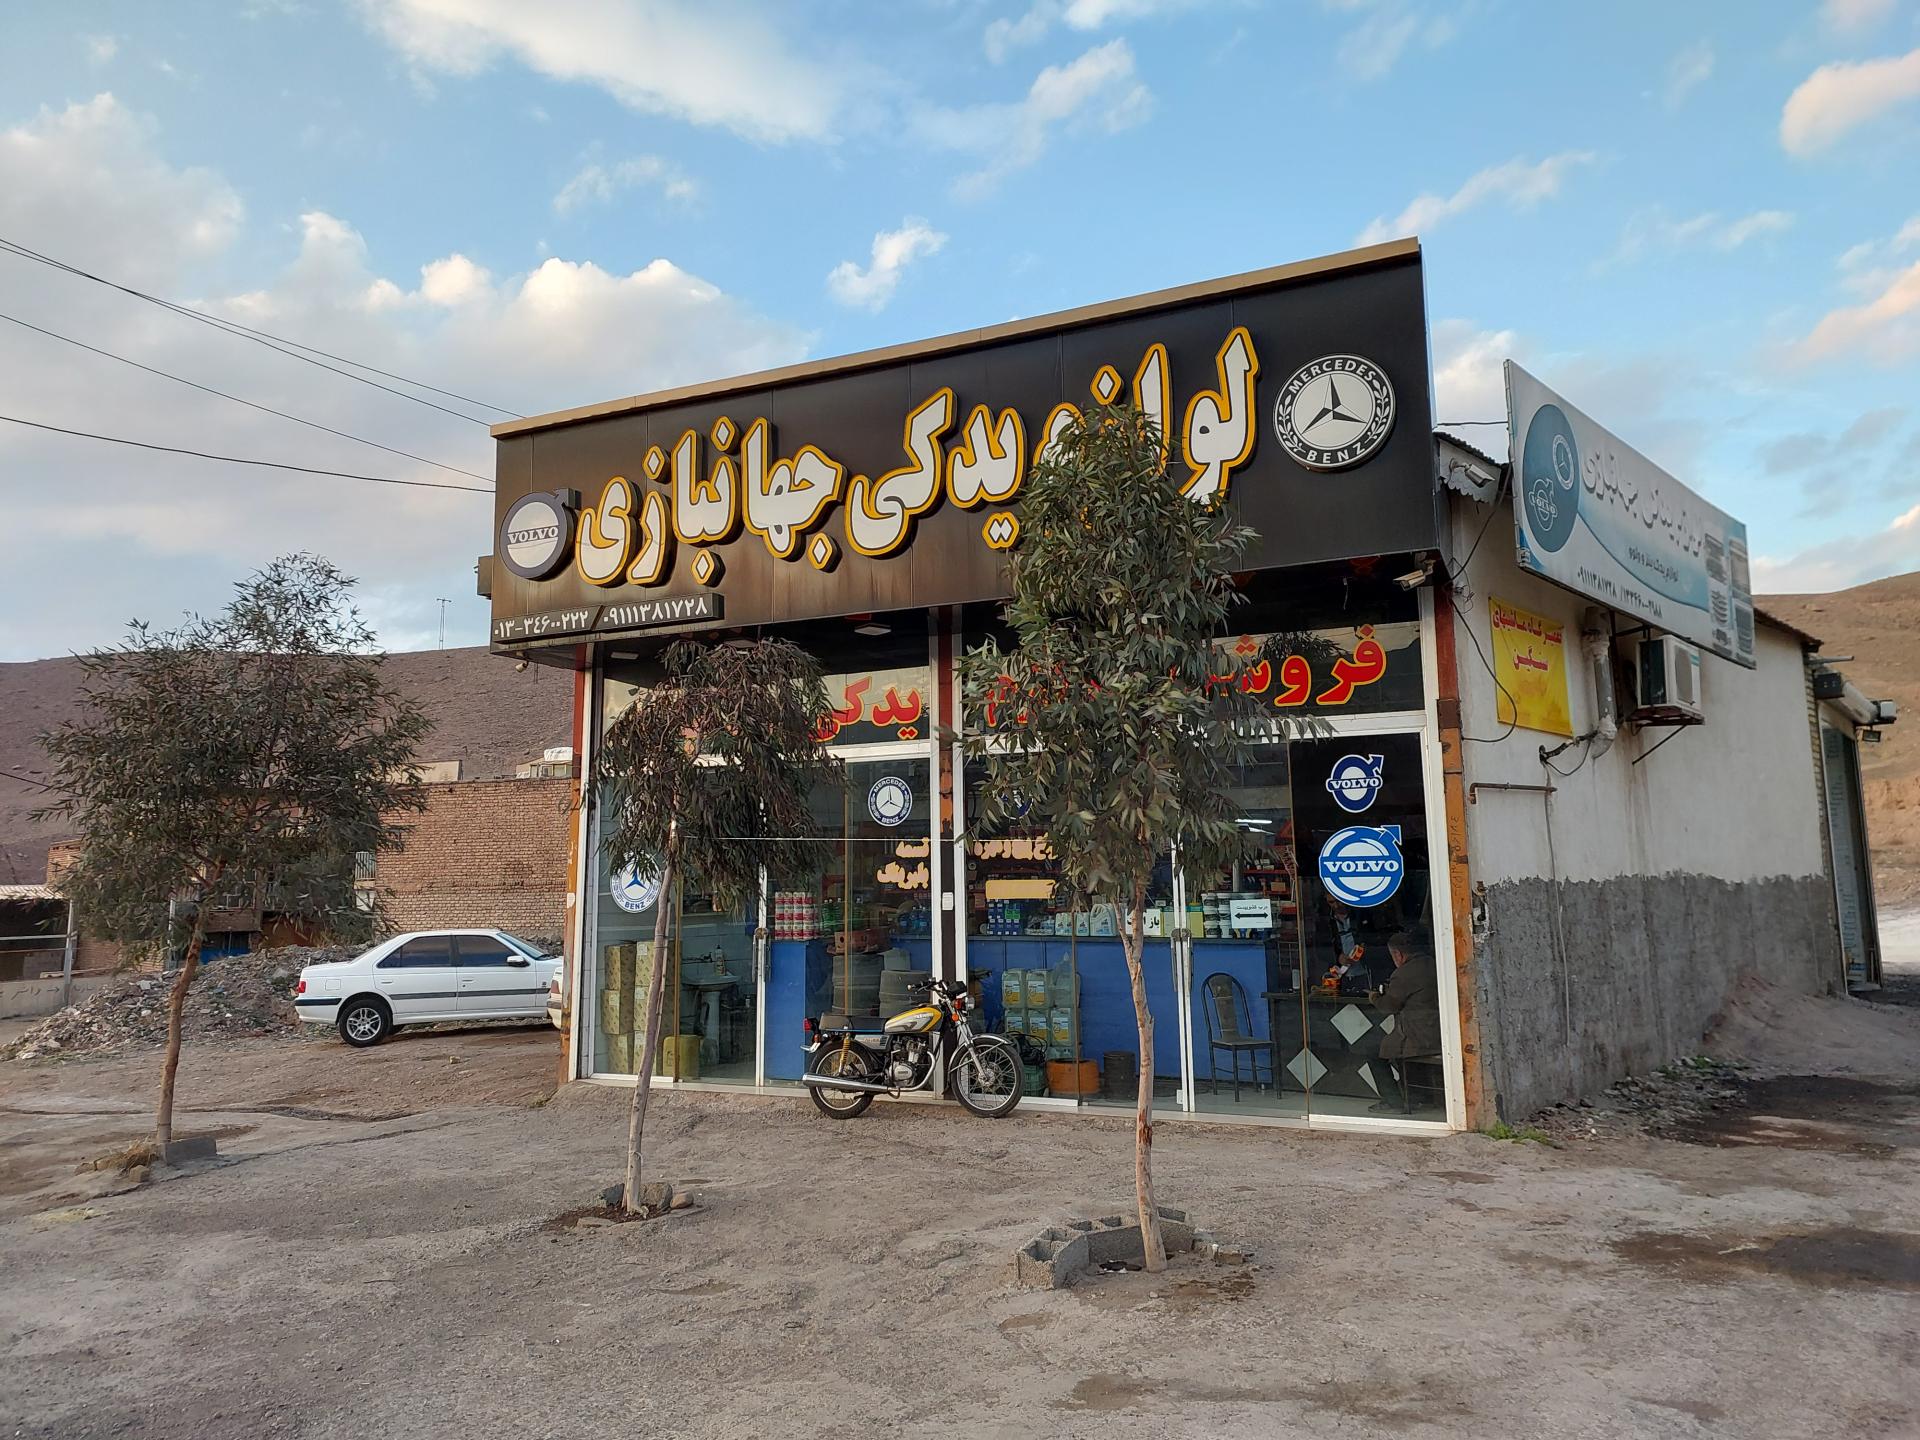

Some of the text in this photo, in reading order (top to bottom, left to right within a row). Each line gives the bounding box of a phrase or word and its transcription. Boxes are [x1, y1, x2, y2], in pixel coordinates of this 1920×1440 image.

[1289, 359, 1377, 394] MERCEDES
[1306, 442, 1366, 464] BENZ
[845, 386, 1027, 557] یدکی
[576, 416, 846, 585] جهانبازی
[507, 526, 559, 544] VOLVO
[873, 778, 906, 793] MERCEDES
[1329, 777, 1381, 789] VOLVO
[881, 816, 901, 824] BENZ
[1323, 859, 1400, 874] VOLVO
[624, 901, 646, 910] BENZ
[1148, 915, 1160, 929] باز
